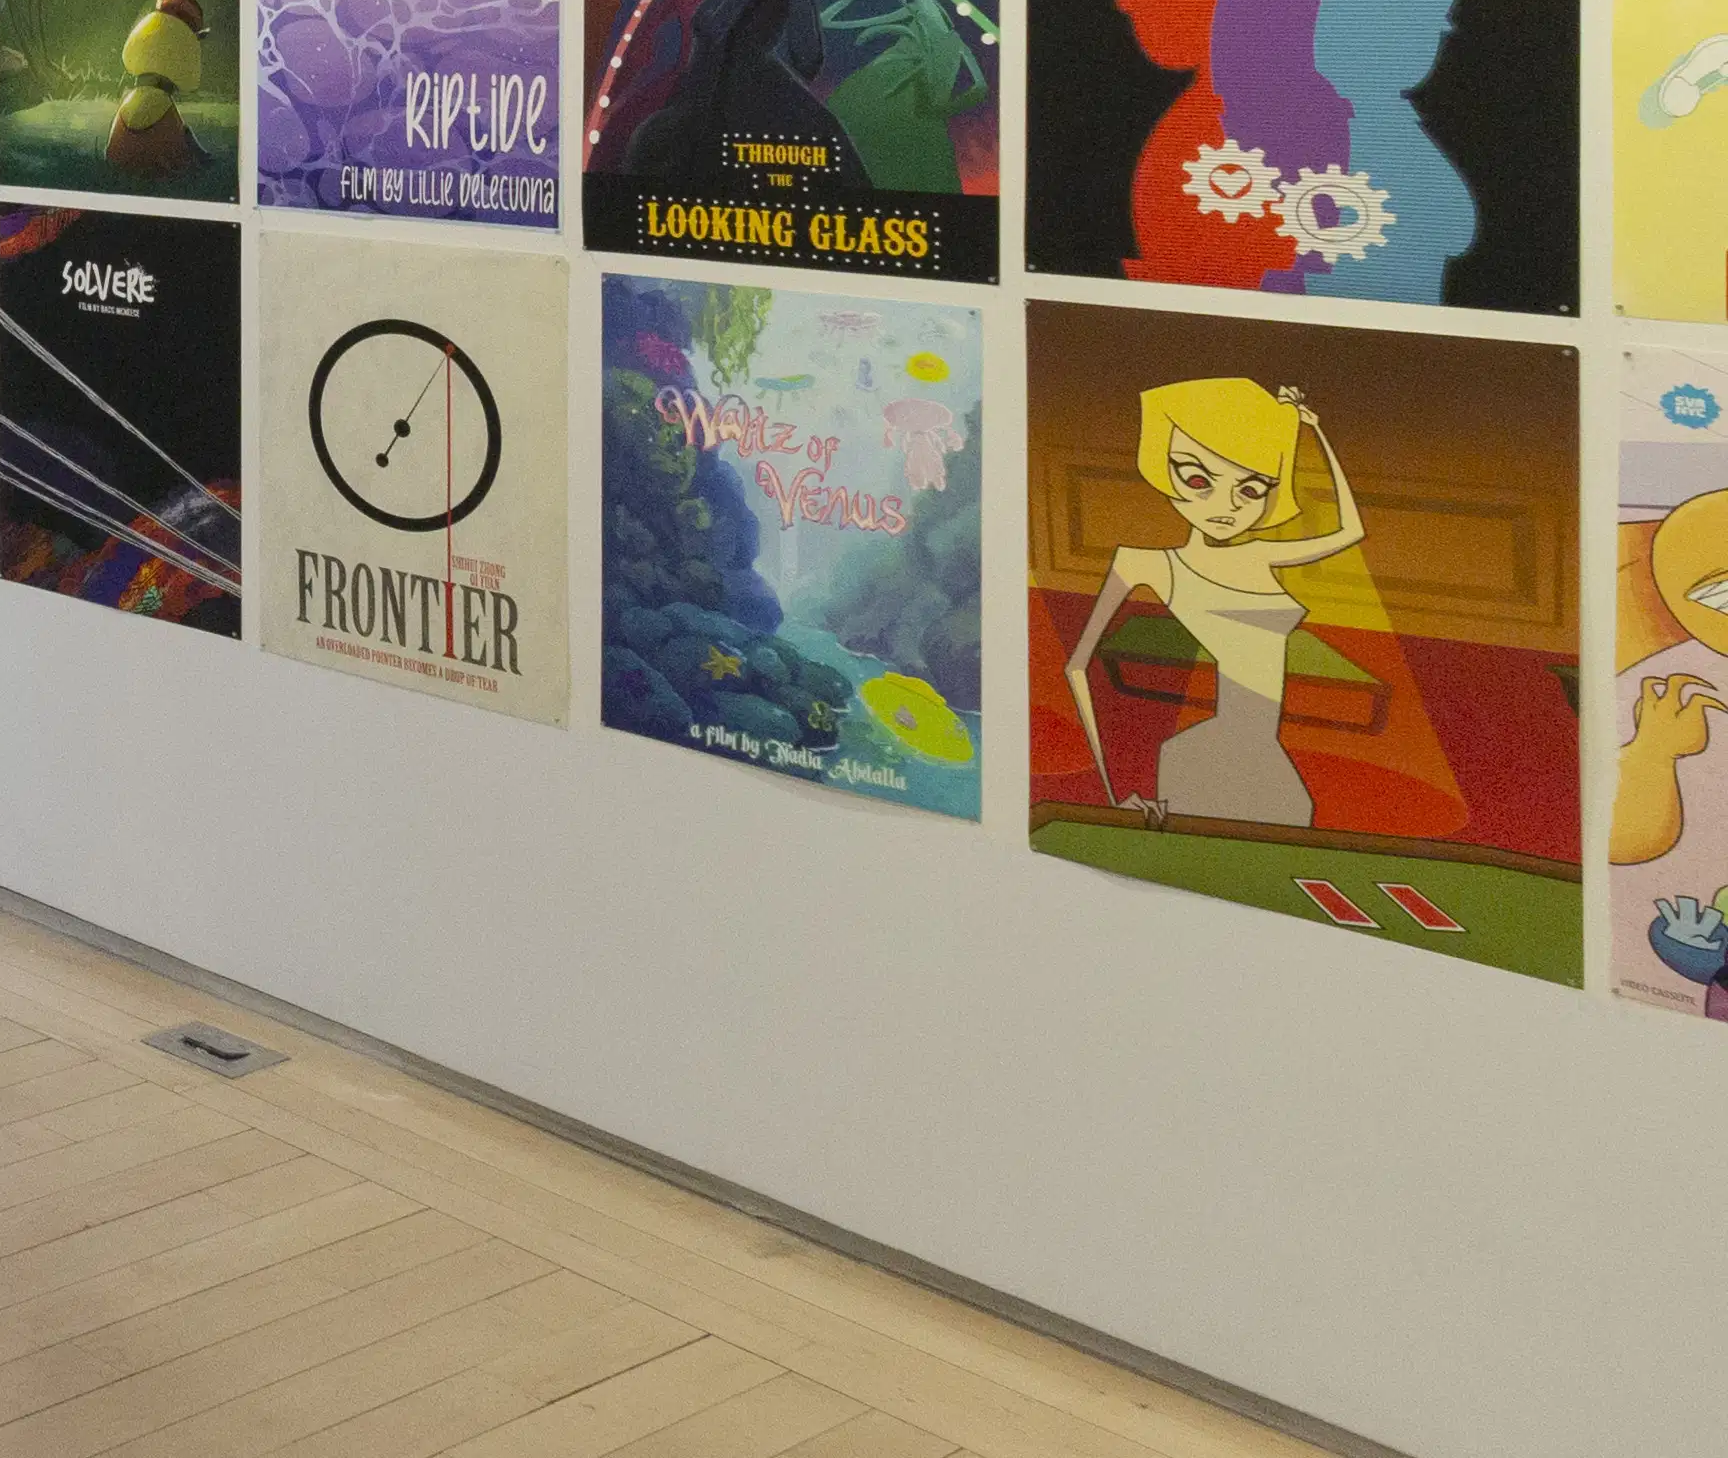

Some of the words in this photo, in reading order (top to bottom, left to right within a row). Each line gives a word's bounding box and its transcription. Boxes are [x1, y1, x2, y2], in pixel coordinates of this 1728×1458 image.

[733, 142, 827, 168] THROUGH
[767, 172, 793, 187] THE
[646, 201, 794, 248] LOOKING
[808, 214, 929, 258] GLASS
[62, 261, 154, 303] SOLVERE
[295, 548, 522, 676] FRONTIER
[316, 635, 325, 649] AN
[326, 638, 371, 660] OVERLOADED
[372, 649, 402, 669] POINTER
[404, 658, 437, 677] BECOMES
[690, 724, 701, 738] a
[741, 734, 760, 759] by
[765, 739, 822, 770] Nadia
